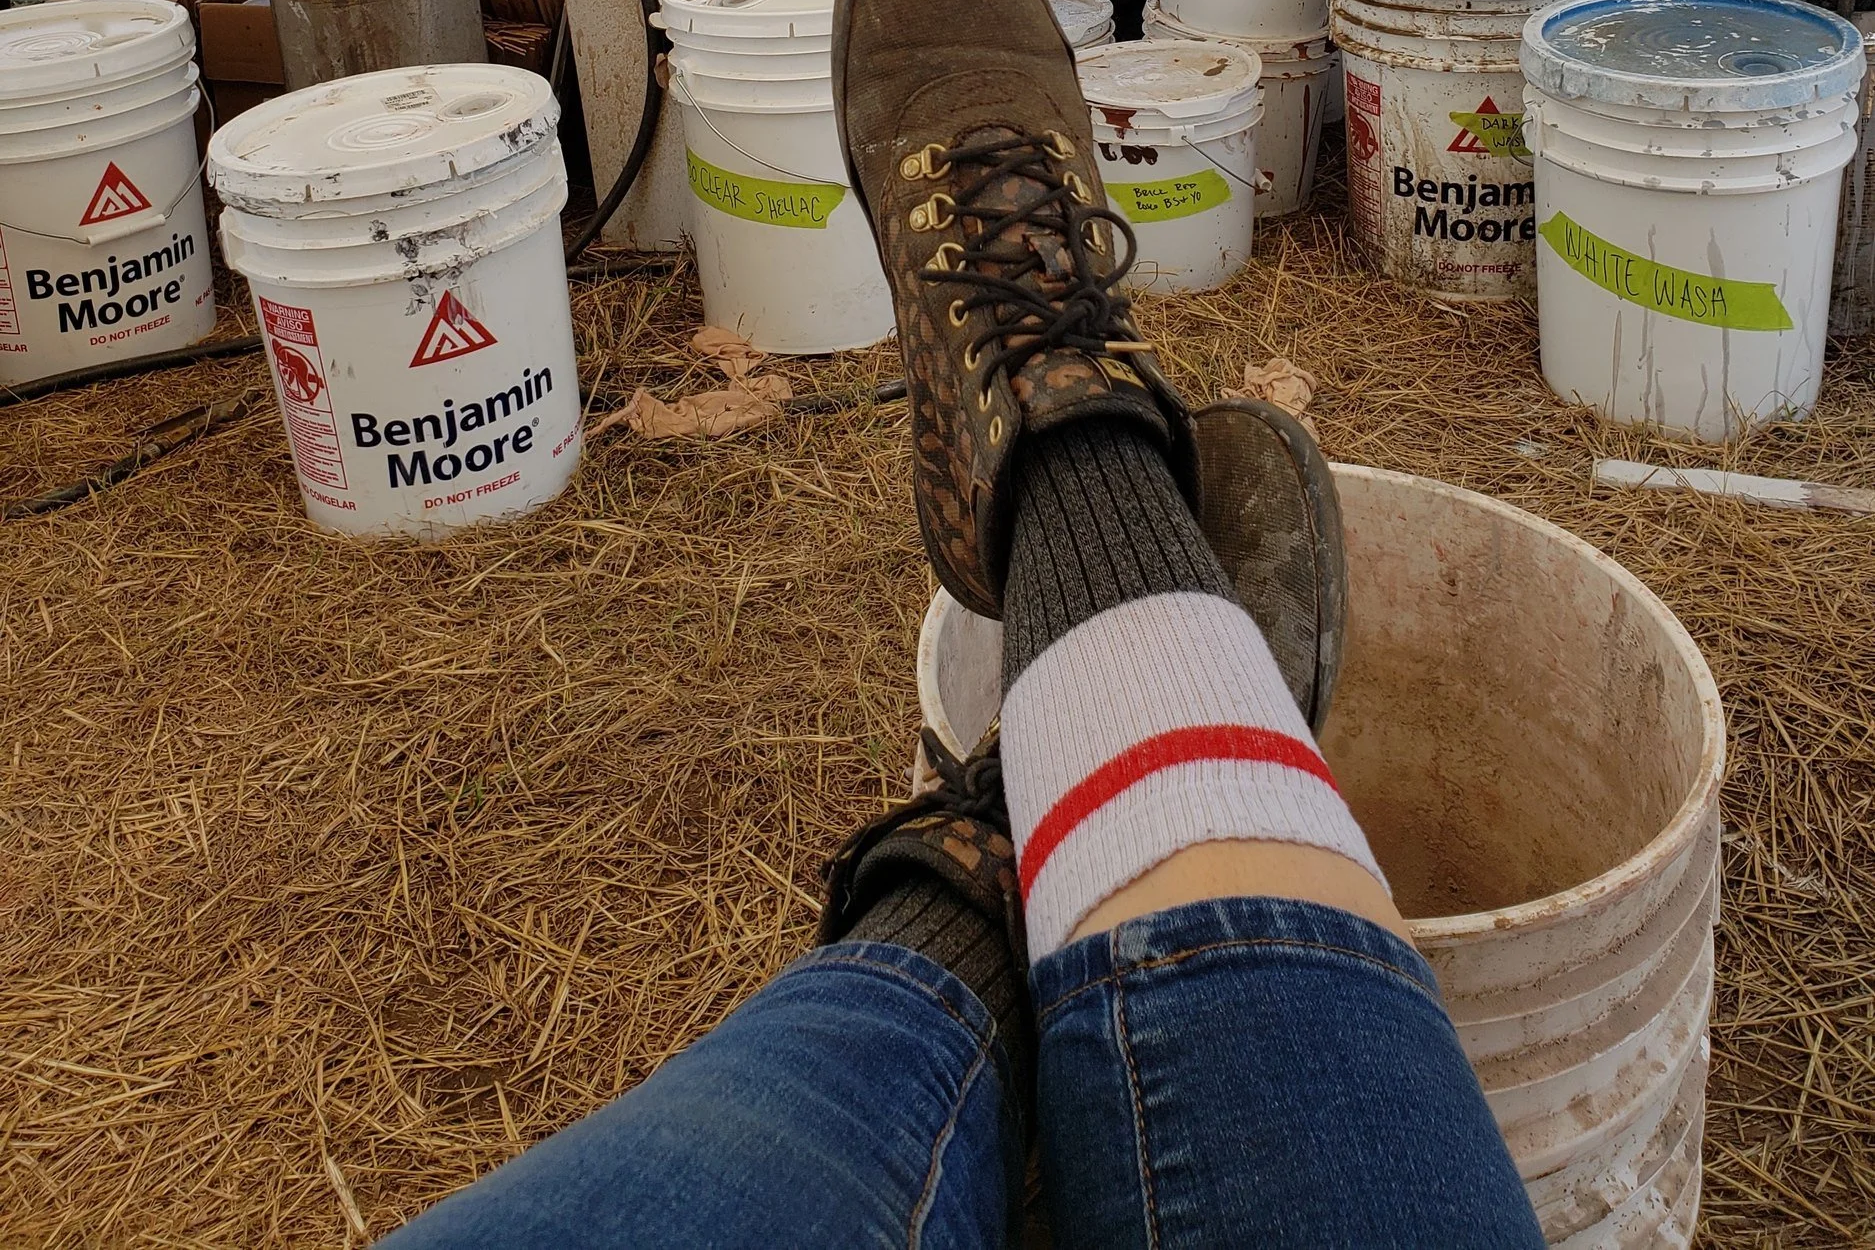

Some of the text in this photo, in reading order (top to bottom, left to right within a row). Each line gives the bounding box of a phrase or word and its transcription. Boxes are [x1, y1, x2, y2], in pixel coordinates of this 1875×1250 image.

[1482, 117, 1519, 130] DARK
[1492, 134, 1526, 148] WAS
[699, 167, 747, 209] CLEAR
[754, 191, 825, 223] SHELLAC
[1174, 182, 1198, 192] RED
[1393, 165, 1535, 215] Benjam
[25, 233, 195, 300] Benjamin
[1438, 261, 1523, 275] DO NOT FREEZE
[1564, 222, 1728, 319] WHITE WASH
[266, 302, 310, 321] WARNING
[276, 316, 304, 332] AVISO
[89, 313, 172, 347] DO NOT FREEZE
[350, 366, 554, 448] Benjamin
[309, 489, 357, 512] CONGELAR
[424, 470, 522, 511] DO NOT FREEZE
